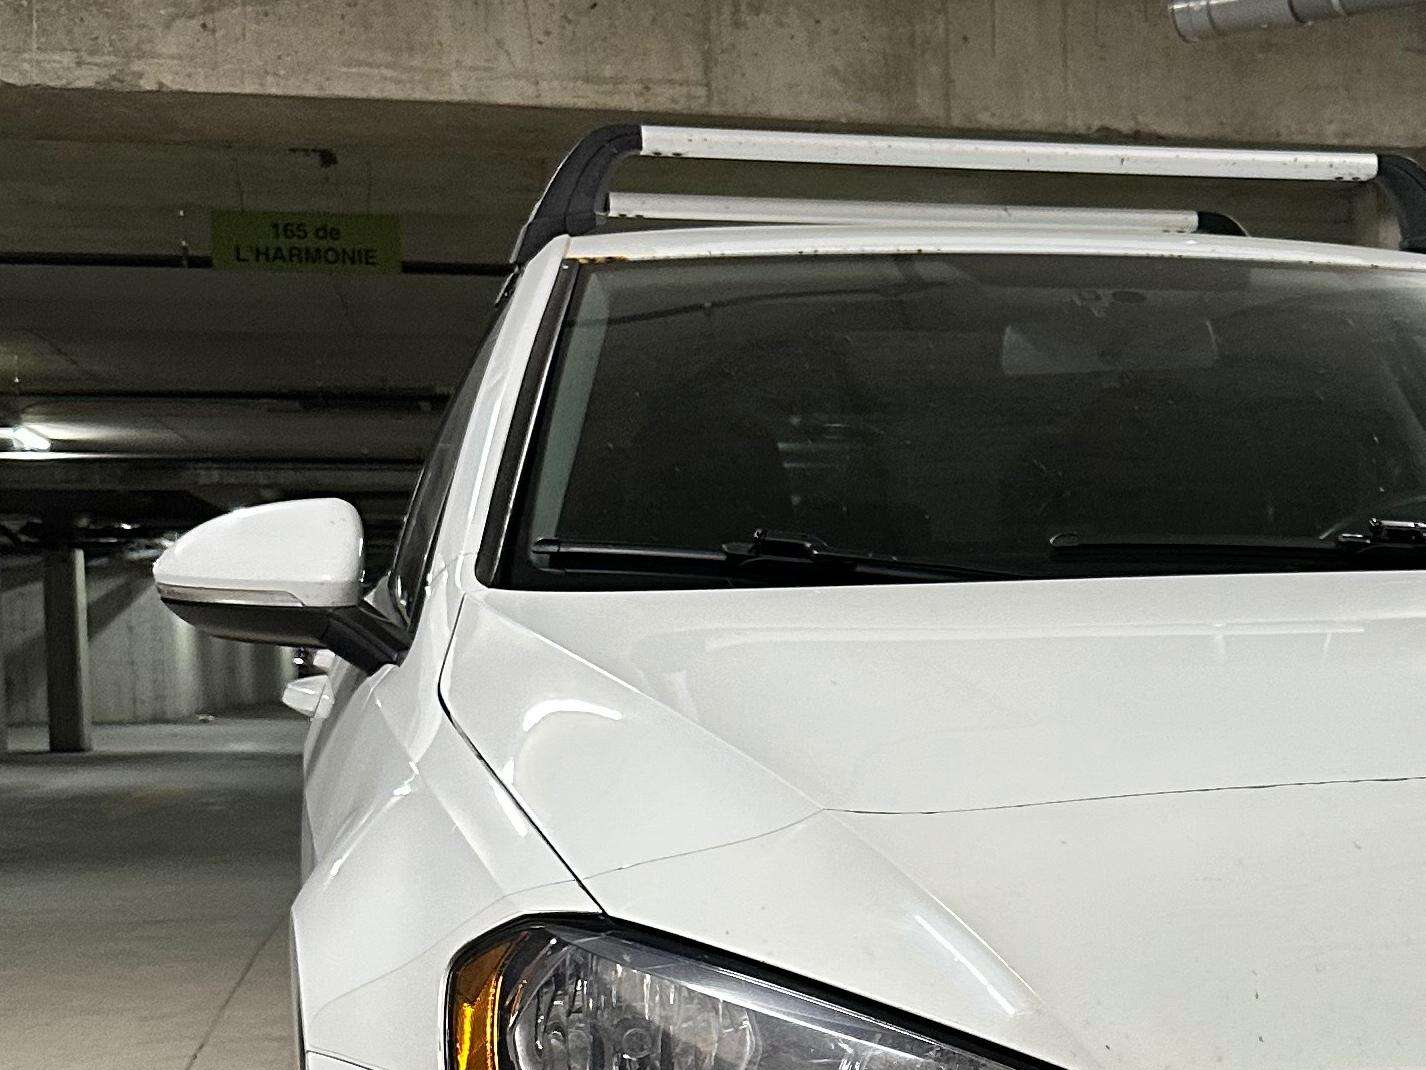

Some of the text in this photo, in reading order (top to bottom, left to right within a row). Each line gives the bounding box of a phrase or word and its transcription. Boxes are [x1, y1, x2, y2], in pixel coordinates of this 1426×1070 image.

[271, 222, 342, 241] 165 de
[234, 246, 379, 266] L'HARMONIE
